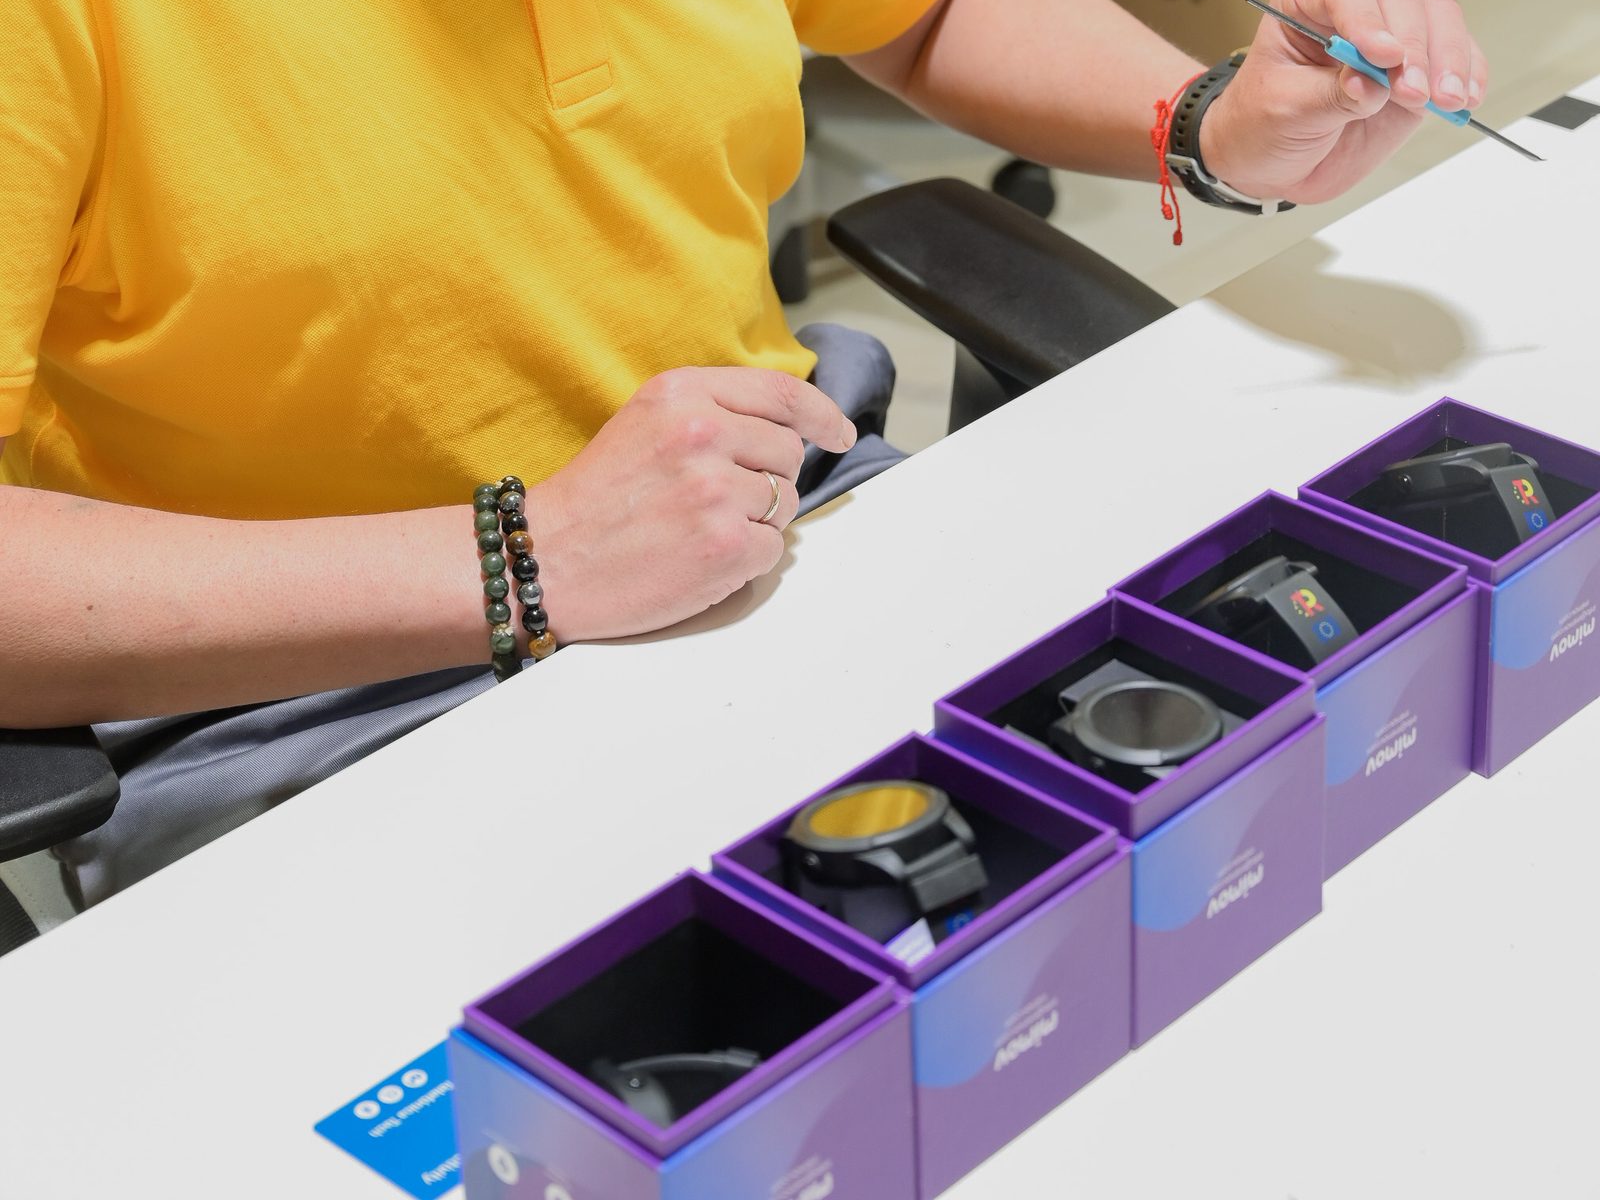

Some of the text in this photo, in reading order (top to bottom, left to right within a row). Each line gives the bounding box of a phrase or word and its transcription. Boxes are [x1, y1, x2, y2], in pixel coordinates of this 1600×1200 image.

[1550, 616, 1596, 662] mimov
[1365, 726, 1417, 777] mimov
[1206, 862, 1264, 919] mimov
